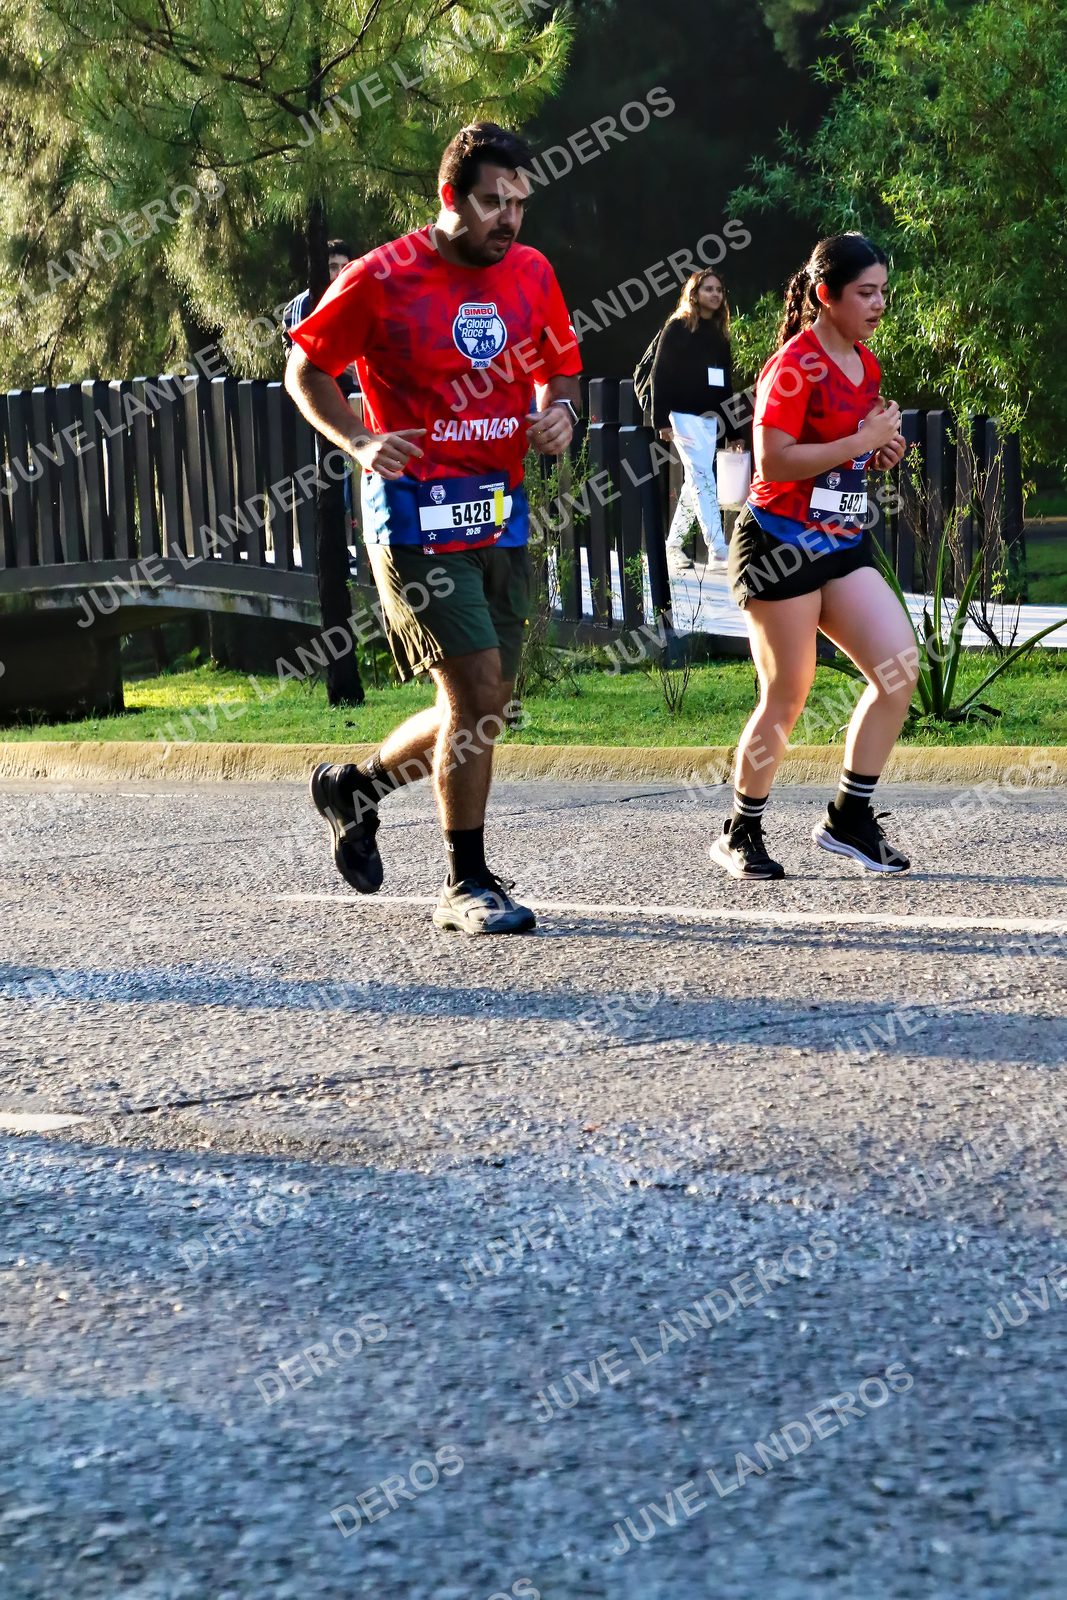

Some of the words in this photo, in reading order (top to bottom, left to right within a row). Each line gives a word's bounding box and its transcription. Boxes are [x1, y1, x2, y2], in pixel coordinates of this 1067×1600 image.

[464, 307, 493, 316] BIMBO
[466, 318, 493, 329] Global
[461, 327, 484, 338] Race
[431, 417, 519, 441] SANTIAGO
[452, 501, 491, 526] 5428
